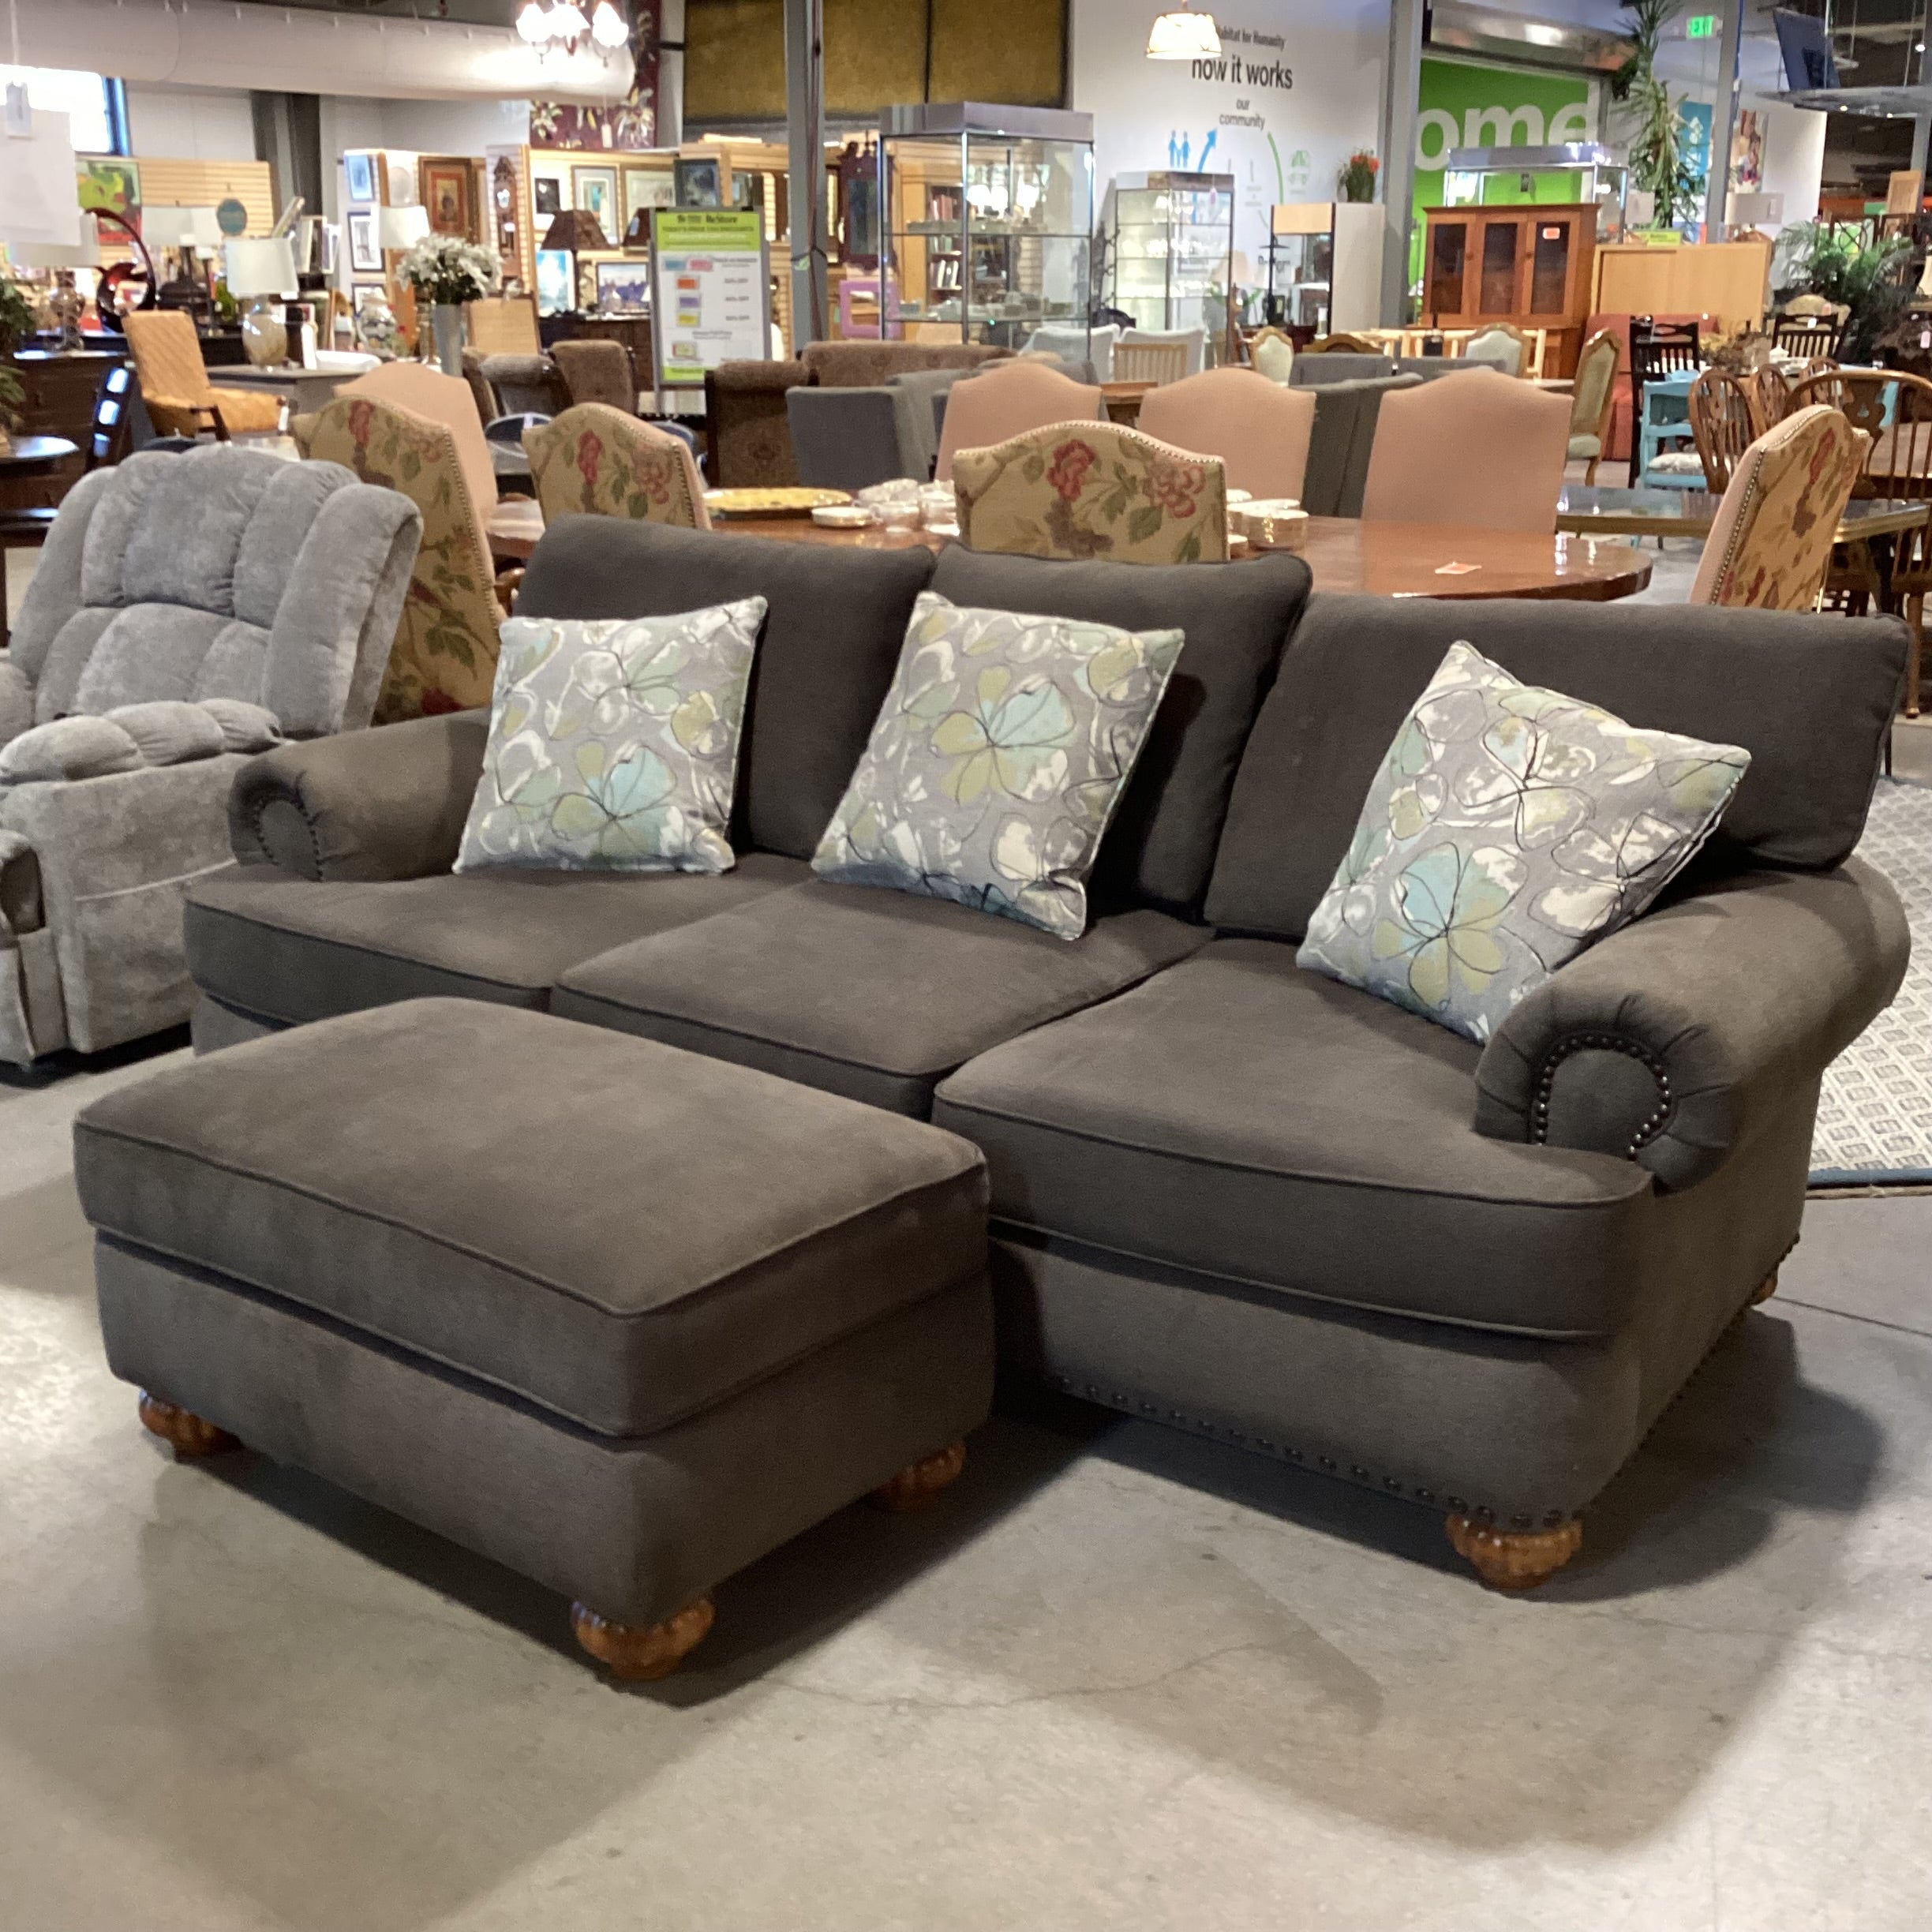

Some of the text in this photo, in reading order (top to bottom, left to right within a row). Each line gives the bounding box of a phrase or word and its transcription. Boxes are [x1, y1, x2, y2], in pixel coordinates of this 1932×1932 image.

[1231, 54, 1241, 84] it
[1246, 59, 1293, 90] works
[1235, 99, 1250, 110] our
[1219, 114, 1265, 131] community
